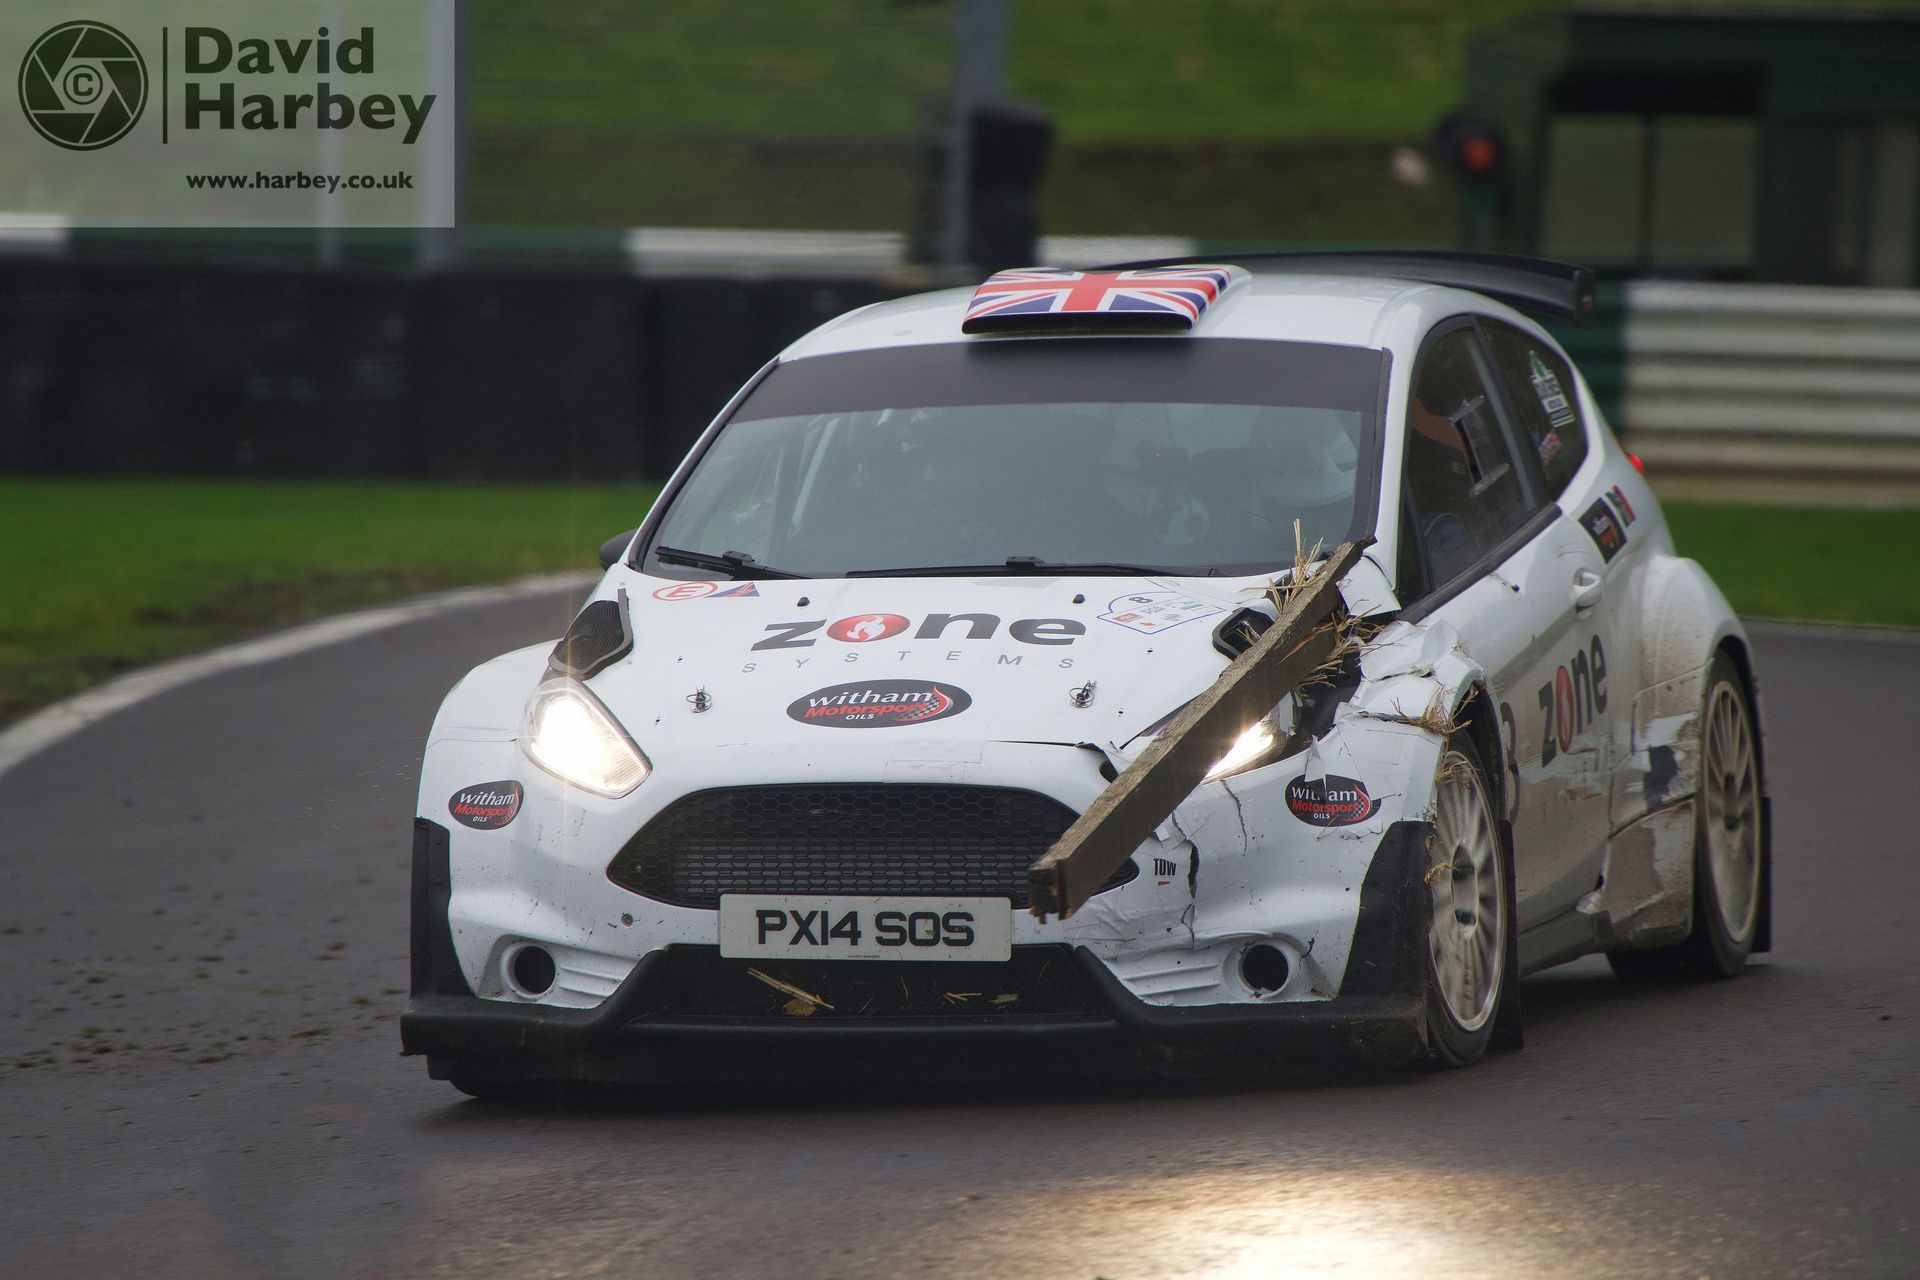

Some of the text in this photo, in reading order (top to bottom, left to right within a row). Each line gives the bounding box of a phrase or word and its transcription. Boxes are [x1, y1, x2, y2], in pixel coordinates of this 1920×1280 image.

[809, 689, 933, 708] witham
[803, 702, 927, 719] Motorsport
[845, 713, 875, 721] OILS
[460, 791, 515, 806] witham
[1292, 799, 1358, 815] Motorsport
[1153, 858, 1177, 876] TOW
[756, 910, 974, 947] PX14 SOS
